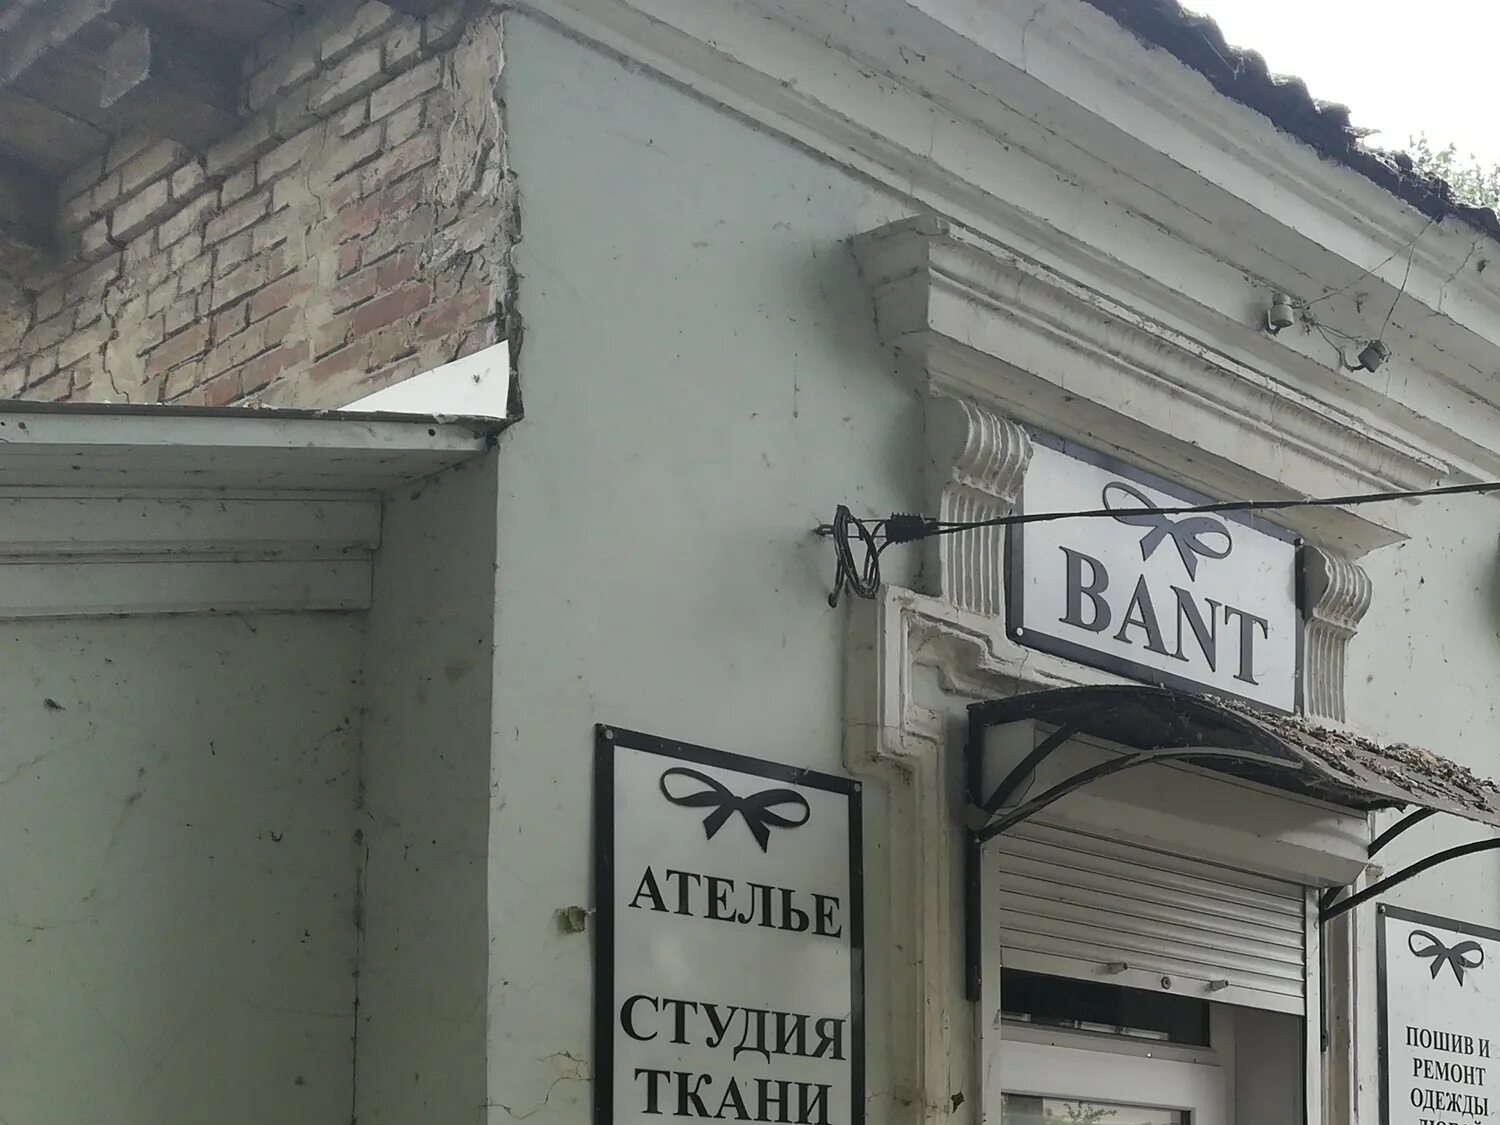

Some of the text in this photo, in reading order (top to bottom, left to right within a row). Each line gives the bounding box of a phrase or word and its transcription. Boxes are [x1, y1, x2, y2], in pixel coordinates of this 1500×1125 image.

[1058, 546, 1269, 686] BANT
[628, 866, 843, 939] АТЕЛЬЕ
[620, 995, 847, 1065] СТУДИЯ
[1406, 1026, 1491, 1059] ПОШИВ И
[1412, 1057, 1486, 1087] РЕМОНТ
[1410, 1087, 1489, 1117] ОДЕЖДЫ
